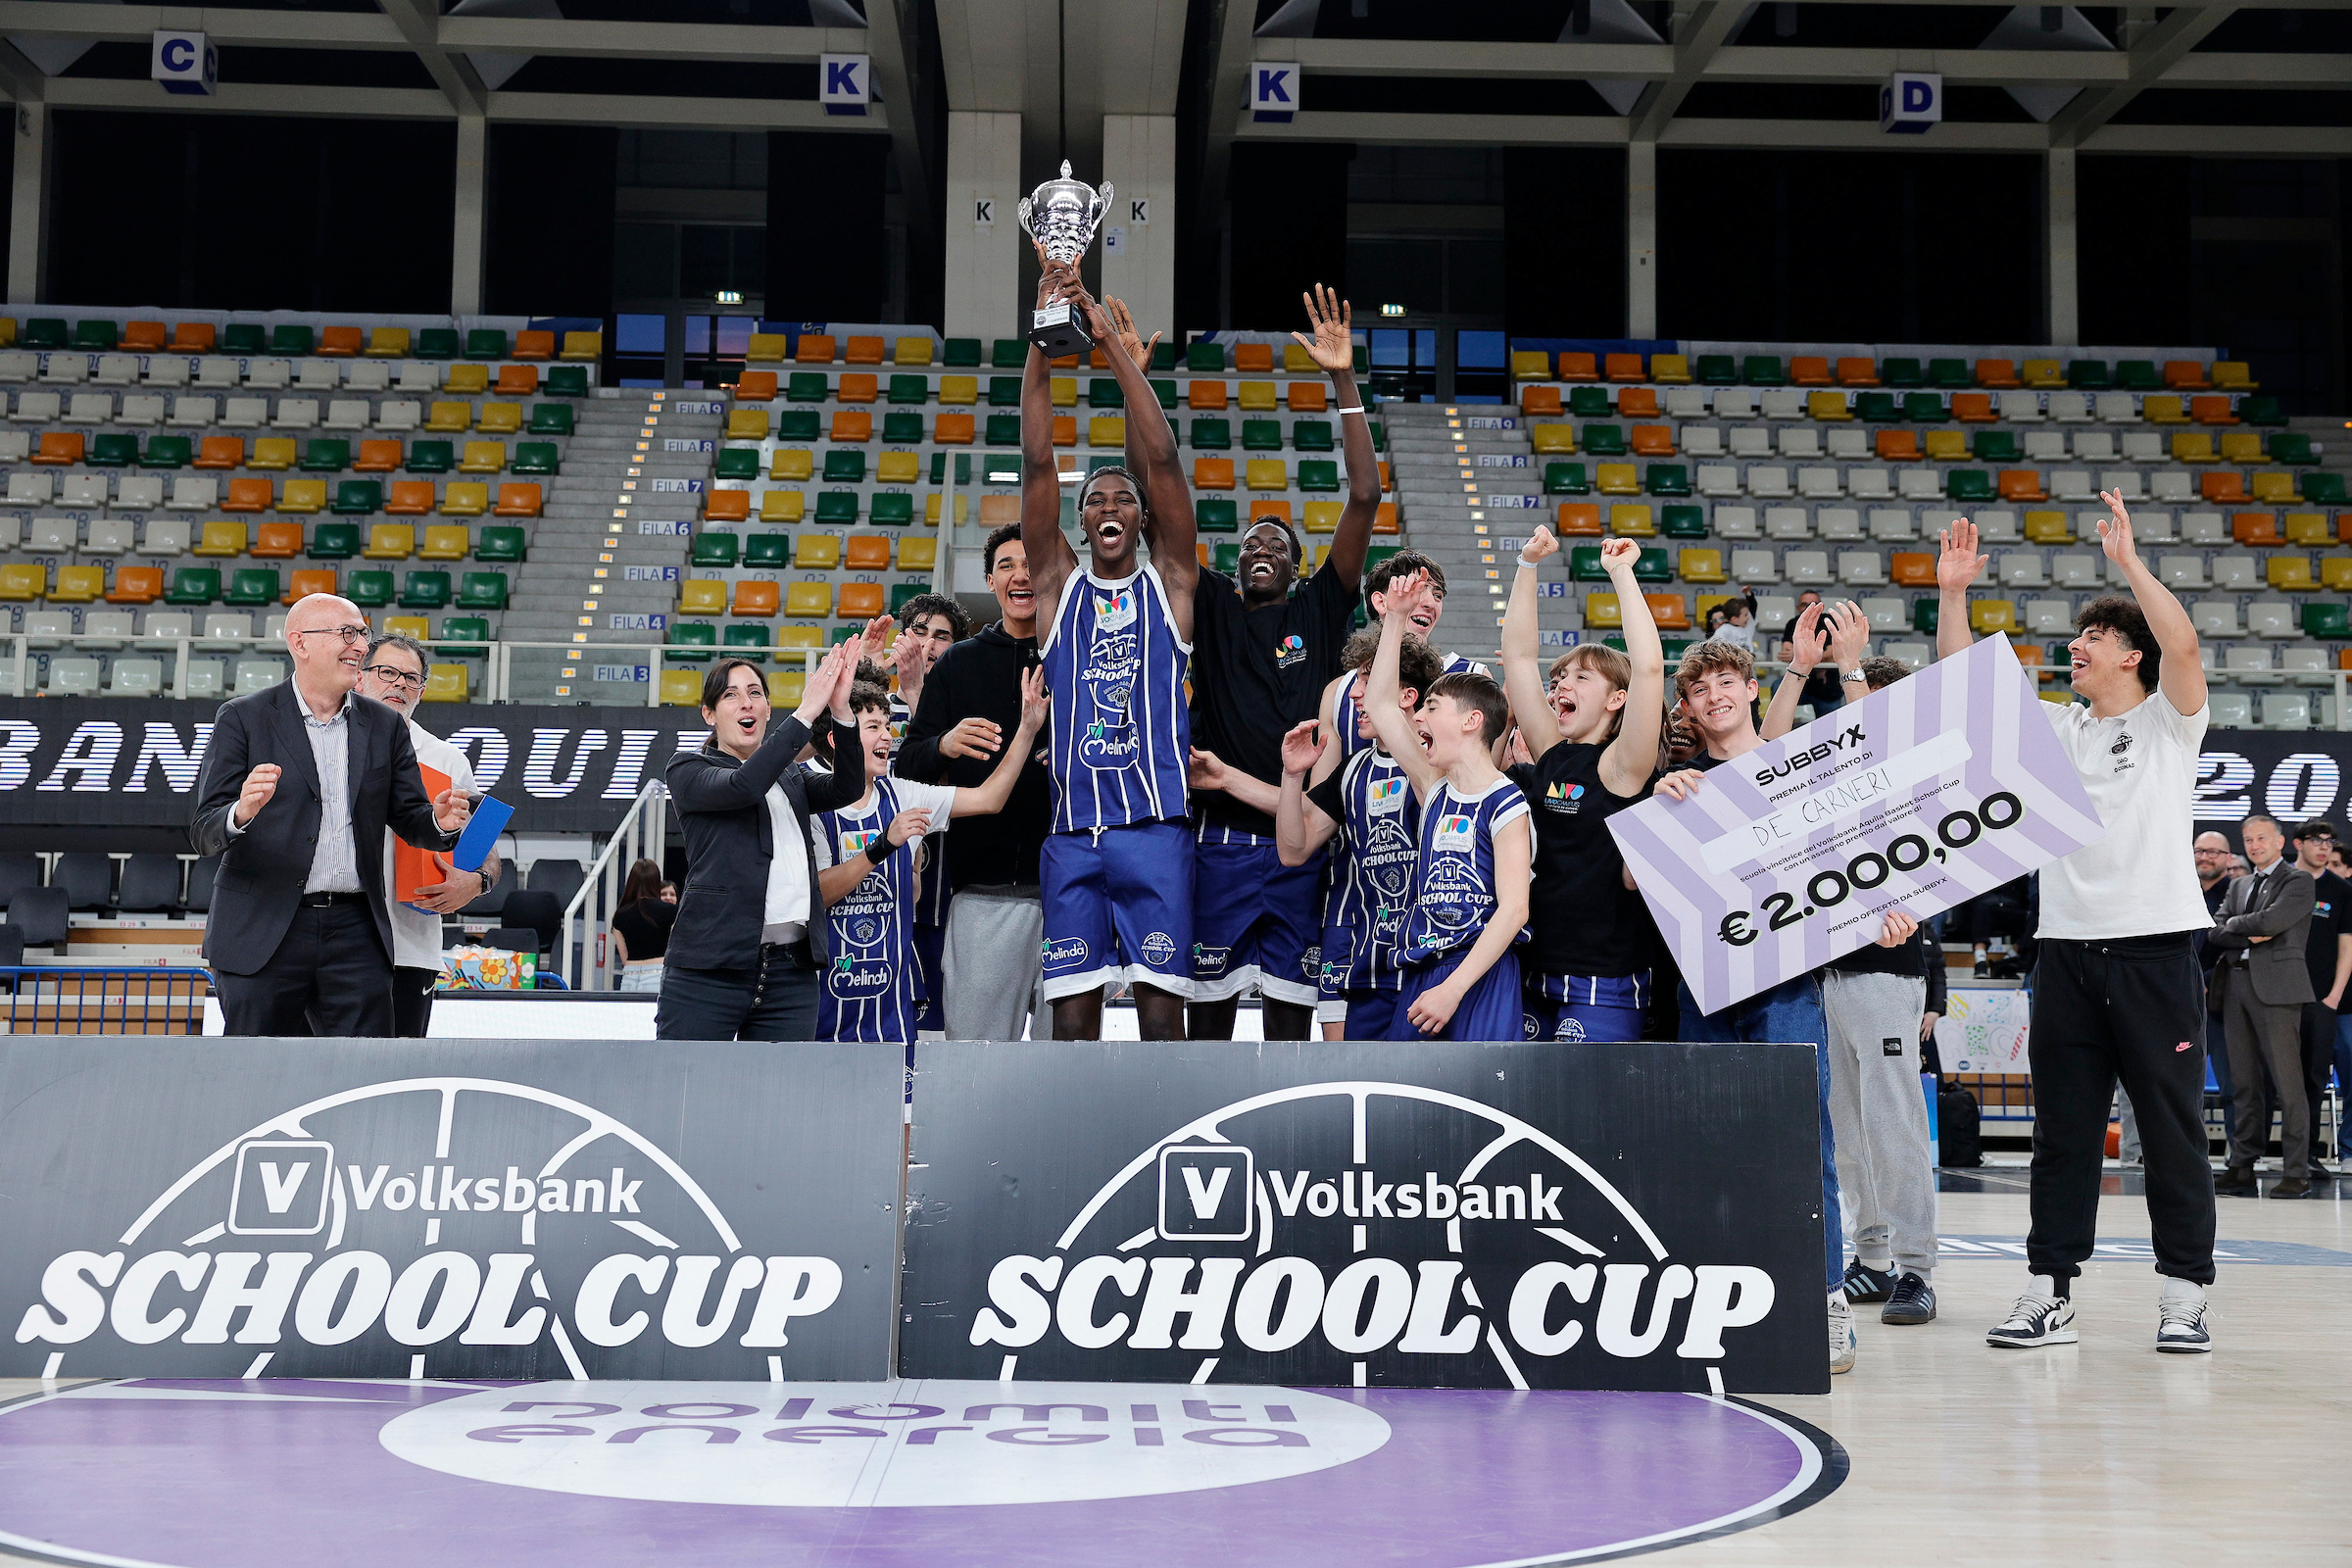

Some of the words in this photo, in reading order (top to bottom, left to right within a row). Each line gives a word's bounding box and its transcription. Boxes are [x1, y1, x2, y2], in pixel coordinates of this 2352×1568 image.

[162, 38, 195, 73] C
[828, 62, 860, 96] K
[1259, 70, 1292, 103] K
[1903, 80, 1934, 113] D
[976, 201, 991, 221] K
[1131, 201, 1147, 221] K
[679, 404, 710, 414] FILA
[711, 403, 722, 414] 9
[1472, 418, 1501, 428] FILA
[1502, 418, 1512, 428] 9
[668, 441, 697, 452] FILA
[702, 442, 713, 452] 8
[1482, 457, 1511, 466] FILA
[1515, 457, 1525, 466] 8
[657, 481, 685, 492] FILA
[692, 481, 703, 492] 7
[1492, 496, 1521, 507] FILA
[1526, 497, 1537, 507] 7
[643, 522, 672, 535] FILA
[678, 523, 689, 535] 6
[629, 567, 659, 580] FILA
[666, 568, 676, 580] 5
[1552, 584, 1562, 597] 5
[614, 615, 646, 628] FILA
[651, 616, 662, 628] 4
[1563, 632, 1576, 646] 4
[598, 667, 631, 681] FILA
[638, 667, 648, 681] 3
[1755, 723, 1866, 787] SUBBYX
[1769, 782, 1807, 804] PREMIA
[1807, 779, 1817, 788] IL
[1817, 757, 1861, 780] TALENTO
[1862, 751, 1874, 760] DI
[1753, 813, 1791, 847] DE
[1801, 767, 1892, 823] CARNERI
[1740, 867, 1767, 883] scuola
[1766, 851, 1803, 871] vincitrice
[1803, 845, 1817, 854] del
[1816, 825, 1858, 847] Volksbank
[1859, 813, 1884, 830] Aquila
[1885, 800, 1914, 817] Basket
[1913, 787, 1942, 804] School
[1942, 779, 1960, 790] Cup
[1784, 862, 1798, 871] con
[1799, 856, 1811, 864] un
[1811, 841, 1844, 860] assegno
[1845, 827, 1874, 845] premio
[1874, 821, 1887, 831] dal
[1887, 809, 1913, 824] valore
[1913, 804, 1923, 812] di
[1397, 850, 1419, 861] CUP
[1717, 910, 1759, 947] €
[1760, 791, 2023, 932] 2.000,00
[1465, 893, 1494, 906] CUP
[1826, 916, 1860, 935] PREMIO
[1860, 899, 1899, 919] OFFERTO
[1899, 893, 1913, 902] DA
[1913, 876, 1948, 896] SUBBYX
[1042, 944, 1085, 963] Melinda
[259, 1161, 313, 1213] V
[348, 1164, 644, 1213] Volksbank
[1182, 1166, 1232, 1219] V
[1268, 1170, 1564, 1221] Volksbank
[16, 1250, 547, 1347] SCHOOL
[575, 1254, 843, 1348] CUP
[969, 1255, 1481, 1354] SCHOOL
[1509, 1261, 1775, 1358] CUP
